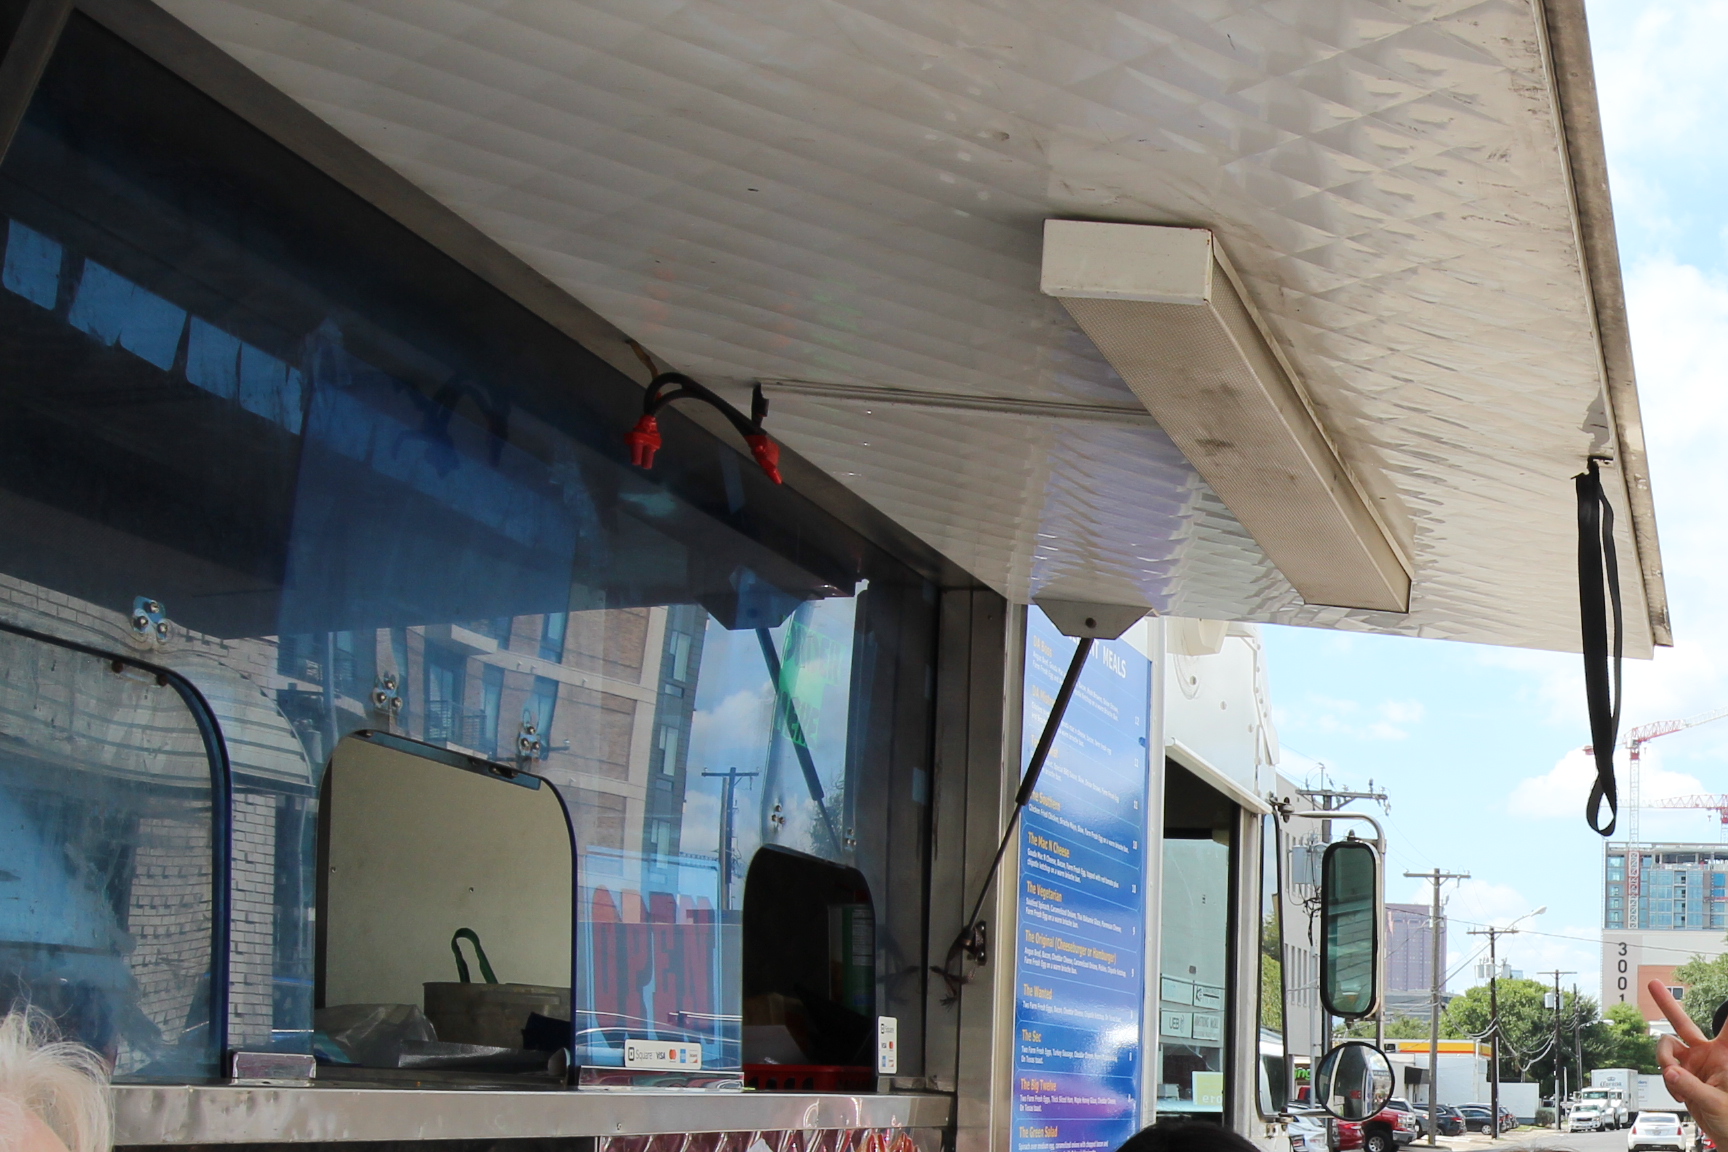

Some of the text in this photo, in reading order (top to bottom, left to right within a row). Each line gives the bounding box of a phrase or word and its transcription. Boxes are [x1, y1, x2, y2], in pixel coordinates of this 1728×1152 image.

[1103, 646, 1127, 679] MEALS
[1040, 792, 1061, 812] Southern
[1028, 831, 1070, 859] The Mac N Cheese
[1027, 881, 1062, 905] The Vegetarian
[1025, 929, 1116, 965] The Original (Cheeseburger or Hamburger)
[1024, 984, 1052, 1000] The Wanted
[1022, 1029, 1042, 1043] The Sec
[636, 1050, 652, 1061] Square
[1021, 1078, 1057, 1093] The Big Twelve
[1019, 1126, 1058, 1138] The Green Salad
